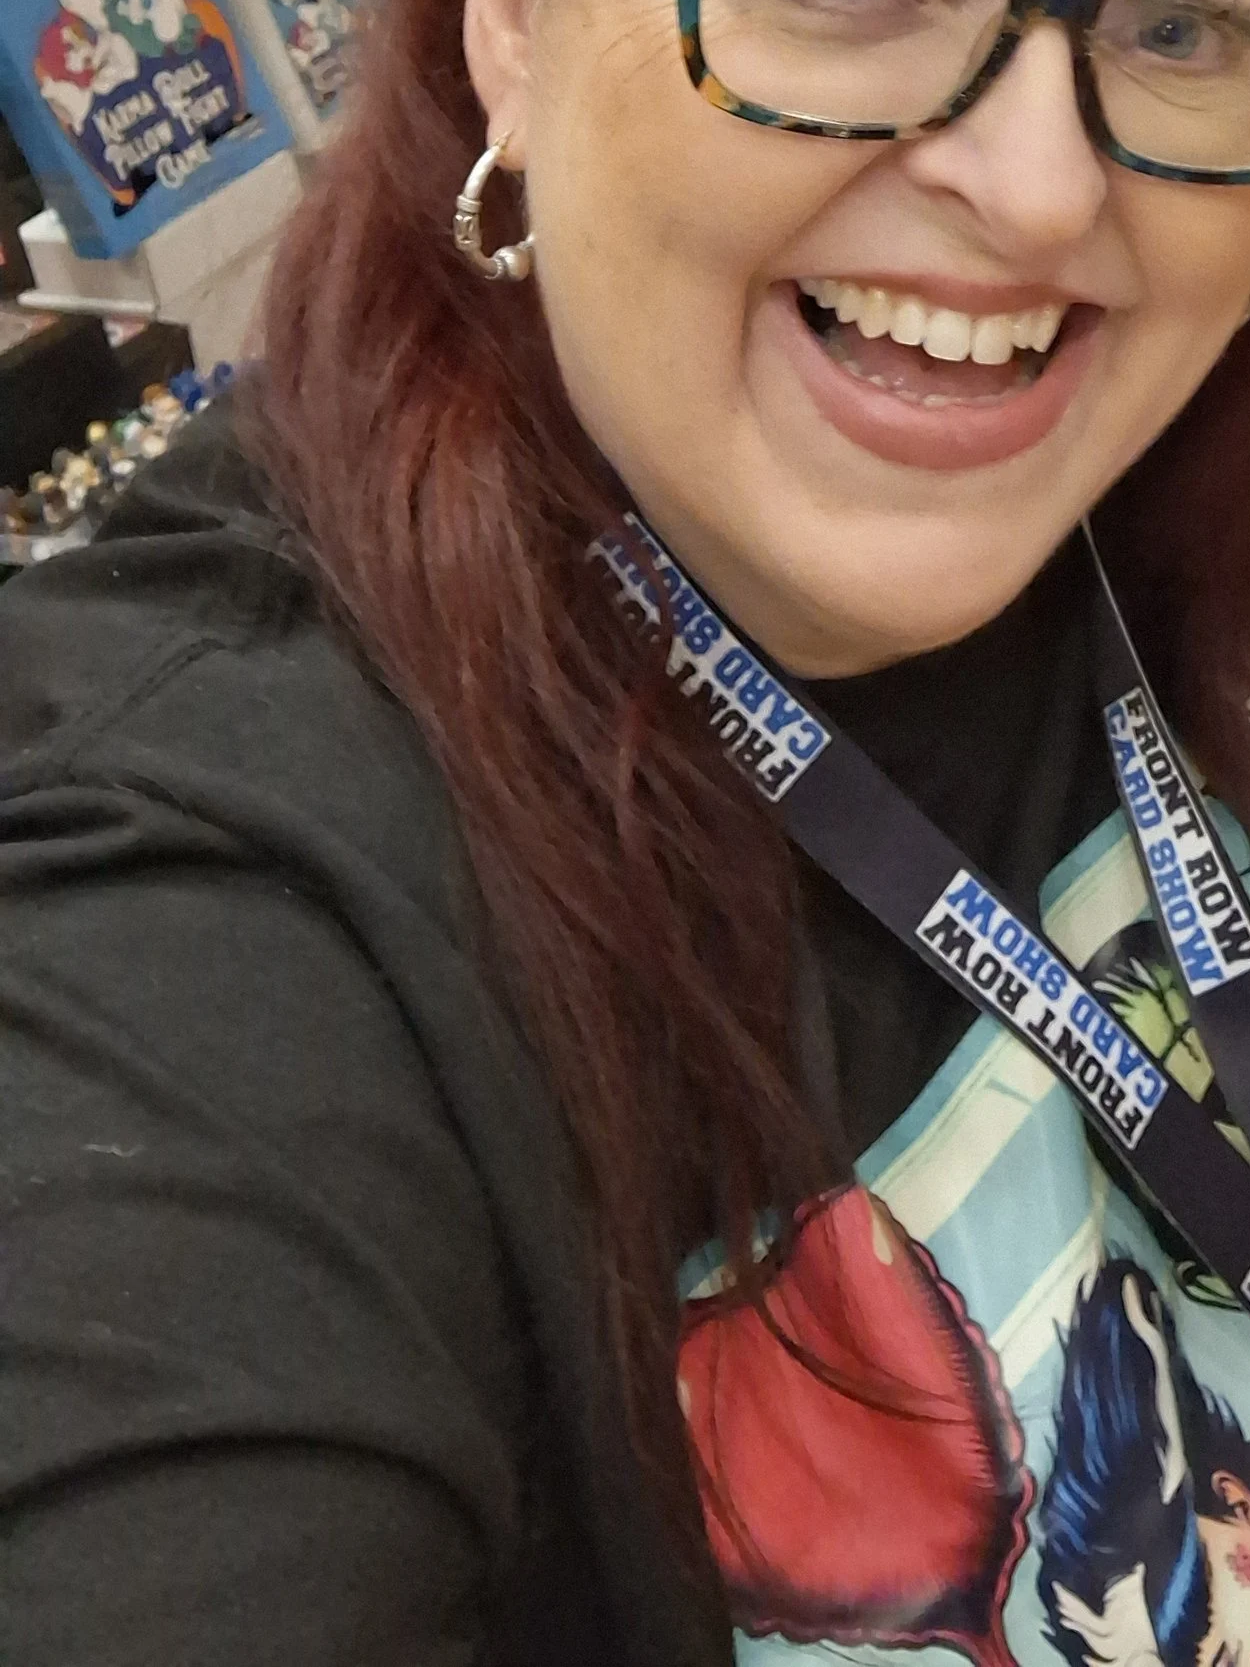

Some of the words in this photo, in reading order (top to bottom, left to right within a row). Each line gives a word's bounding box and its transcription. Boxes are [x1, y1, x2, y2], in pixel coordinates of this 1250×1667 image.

[104, 120, 173, 180] PILLOW
[156, 139, 211, 189] GAME
[714, 646, 824, 761] CARD
[1124, 691, 1205, 839] FRONT
[1106, 702, 1163, 830] CARD
[1148, 837, 1225, 985] SHOW
[922, 913, 1029, 1016] ROW
[945, 878, 1068, 1001] SHOW
[1026, 1007, 1143, 1139] FRONT
[1069, 993, 1163, 1108] CARD
